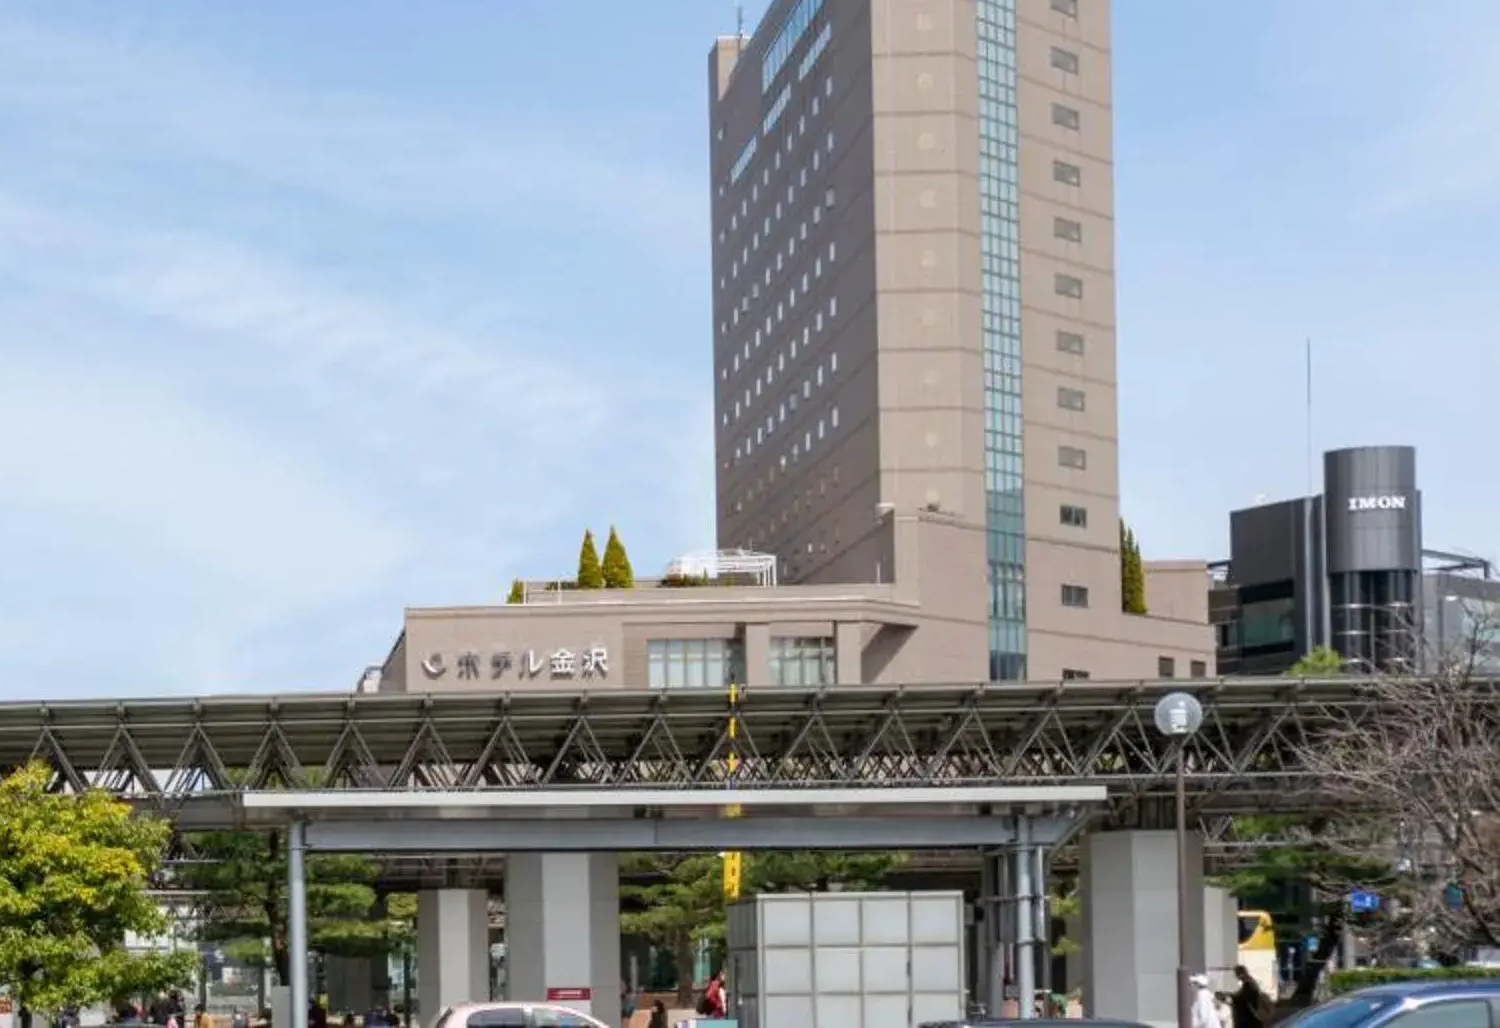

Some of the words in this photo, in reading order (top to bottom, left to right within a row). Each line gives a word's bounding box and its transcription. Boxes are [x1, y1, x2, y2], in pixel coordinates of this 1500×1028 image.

[1347, 496, 1406, 510] IMON
[456, 647, 608, 679] ホテル金沢
